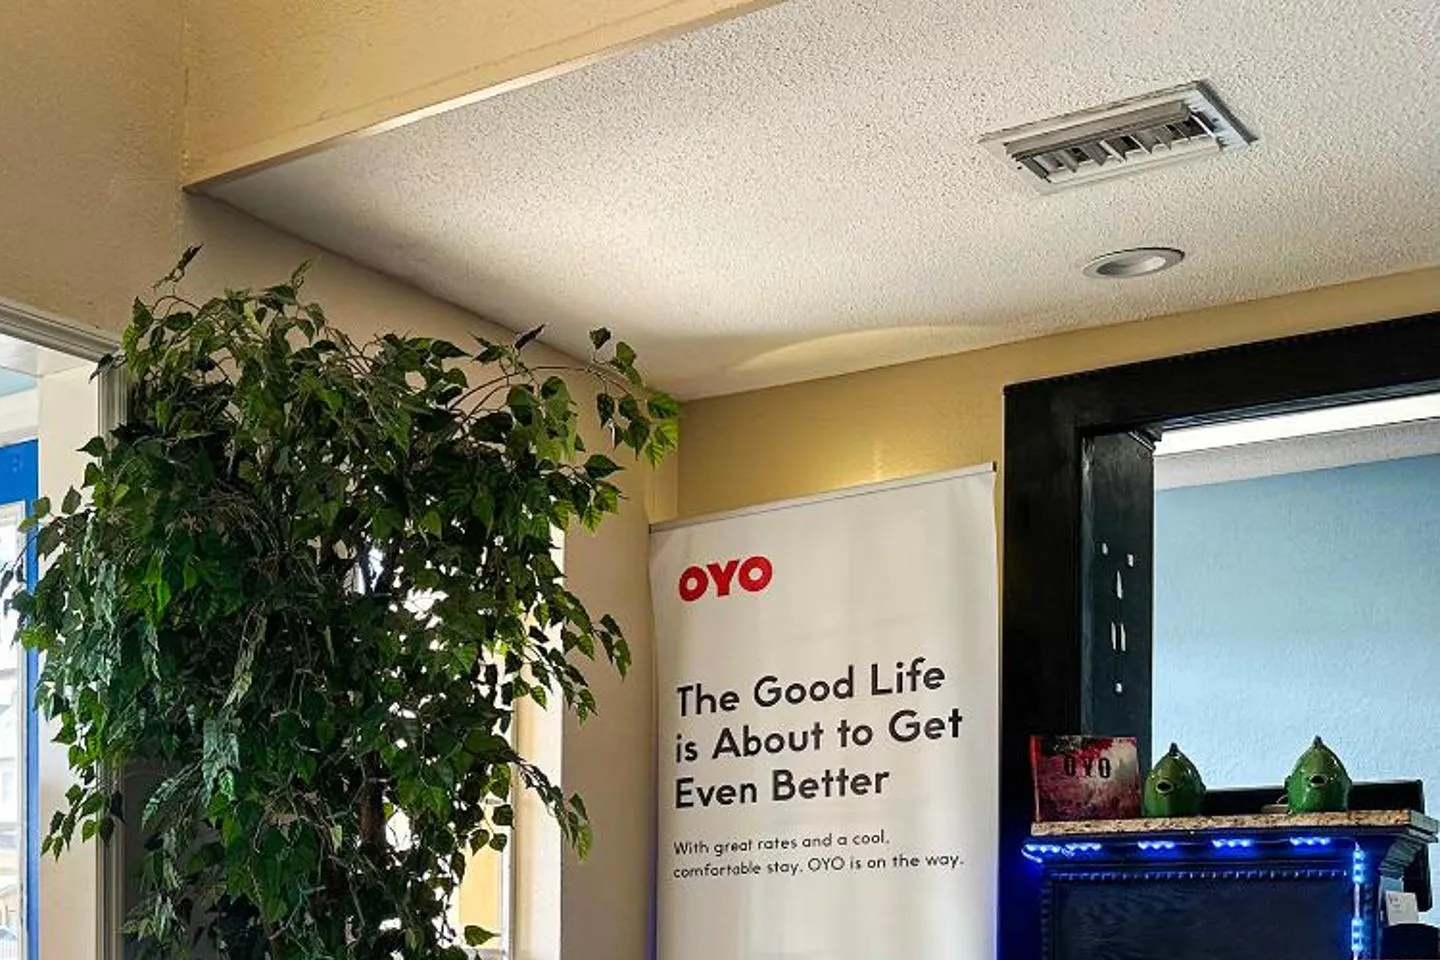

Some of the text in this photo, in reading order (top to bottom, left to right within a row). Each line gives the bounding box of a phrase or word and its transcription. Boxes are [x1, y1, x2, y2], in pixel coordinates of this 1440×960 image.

[678, 556, 773, 602] OYO
[677, 656, 946, 717] The Good Life
[675, 708, 963, 763] is About to Get
[675, 767, 890, 809] Even Better
[673, 840, 709, 855] With
[713, 839, 752, 857] great
[757, 837, 798, 850] rates
[802, 832, 833, 848] and
[836, 835, 848, 846] a
[673, 861, 761, 879] comfortable
[807, 855, 846, 872] OYO
[850, 856, 861, 870] is
[867, 858, 886, 869] on
[892, 853, 921, 868] the
